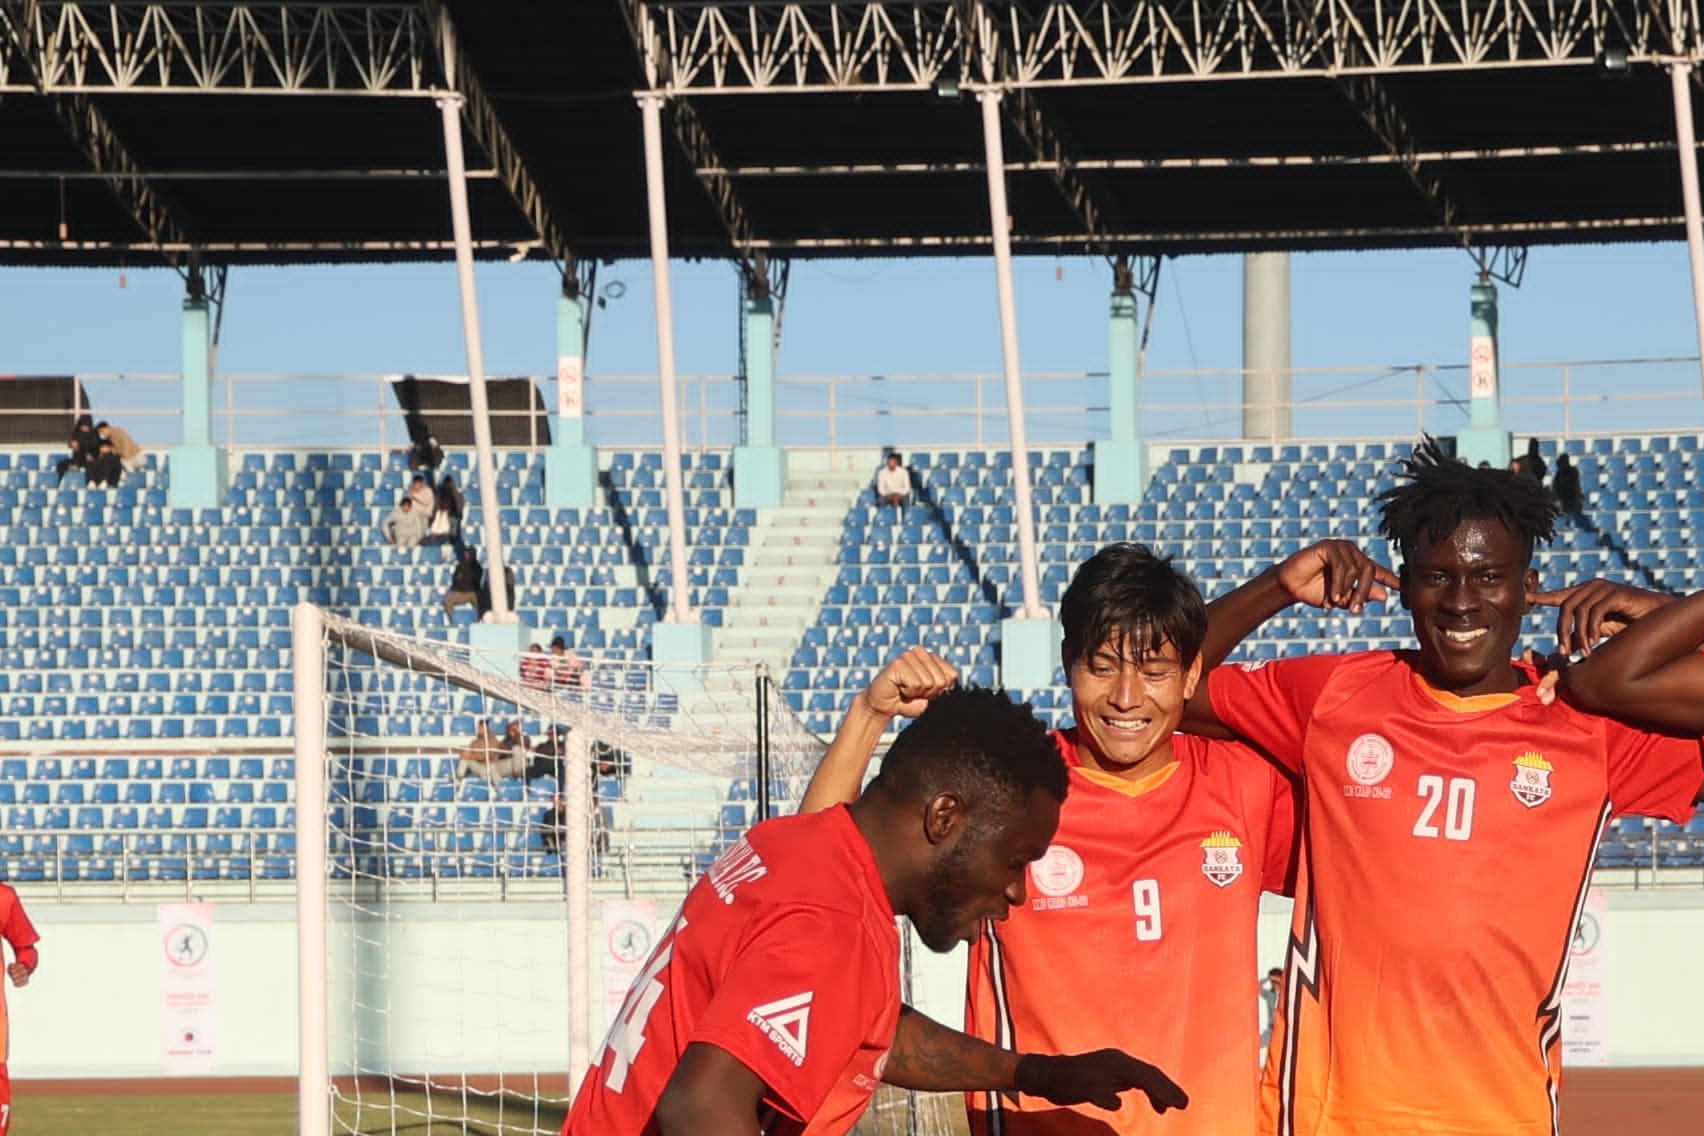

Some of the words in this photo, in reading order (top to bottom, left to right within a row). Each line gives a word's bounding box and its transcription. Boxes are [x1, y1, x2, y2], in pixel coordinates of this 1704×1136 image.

[1412, 774, 1476, 841] 20
[1132, 879, 1163, 942] 9
[746, 1010, 771, 1034] KTM
[768, 1029, 804, 1067] SPORTS
